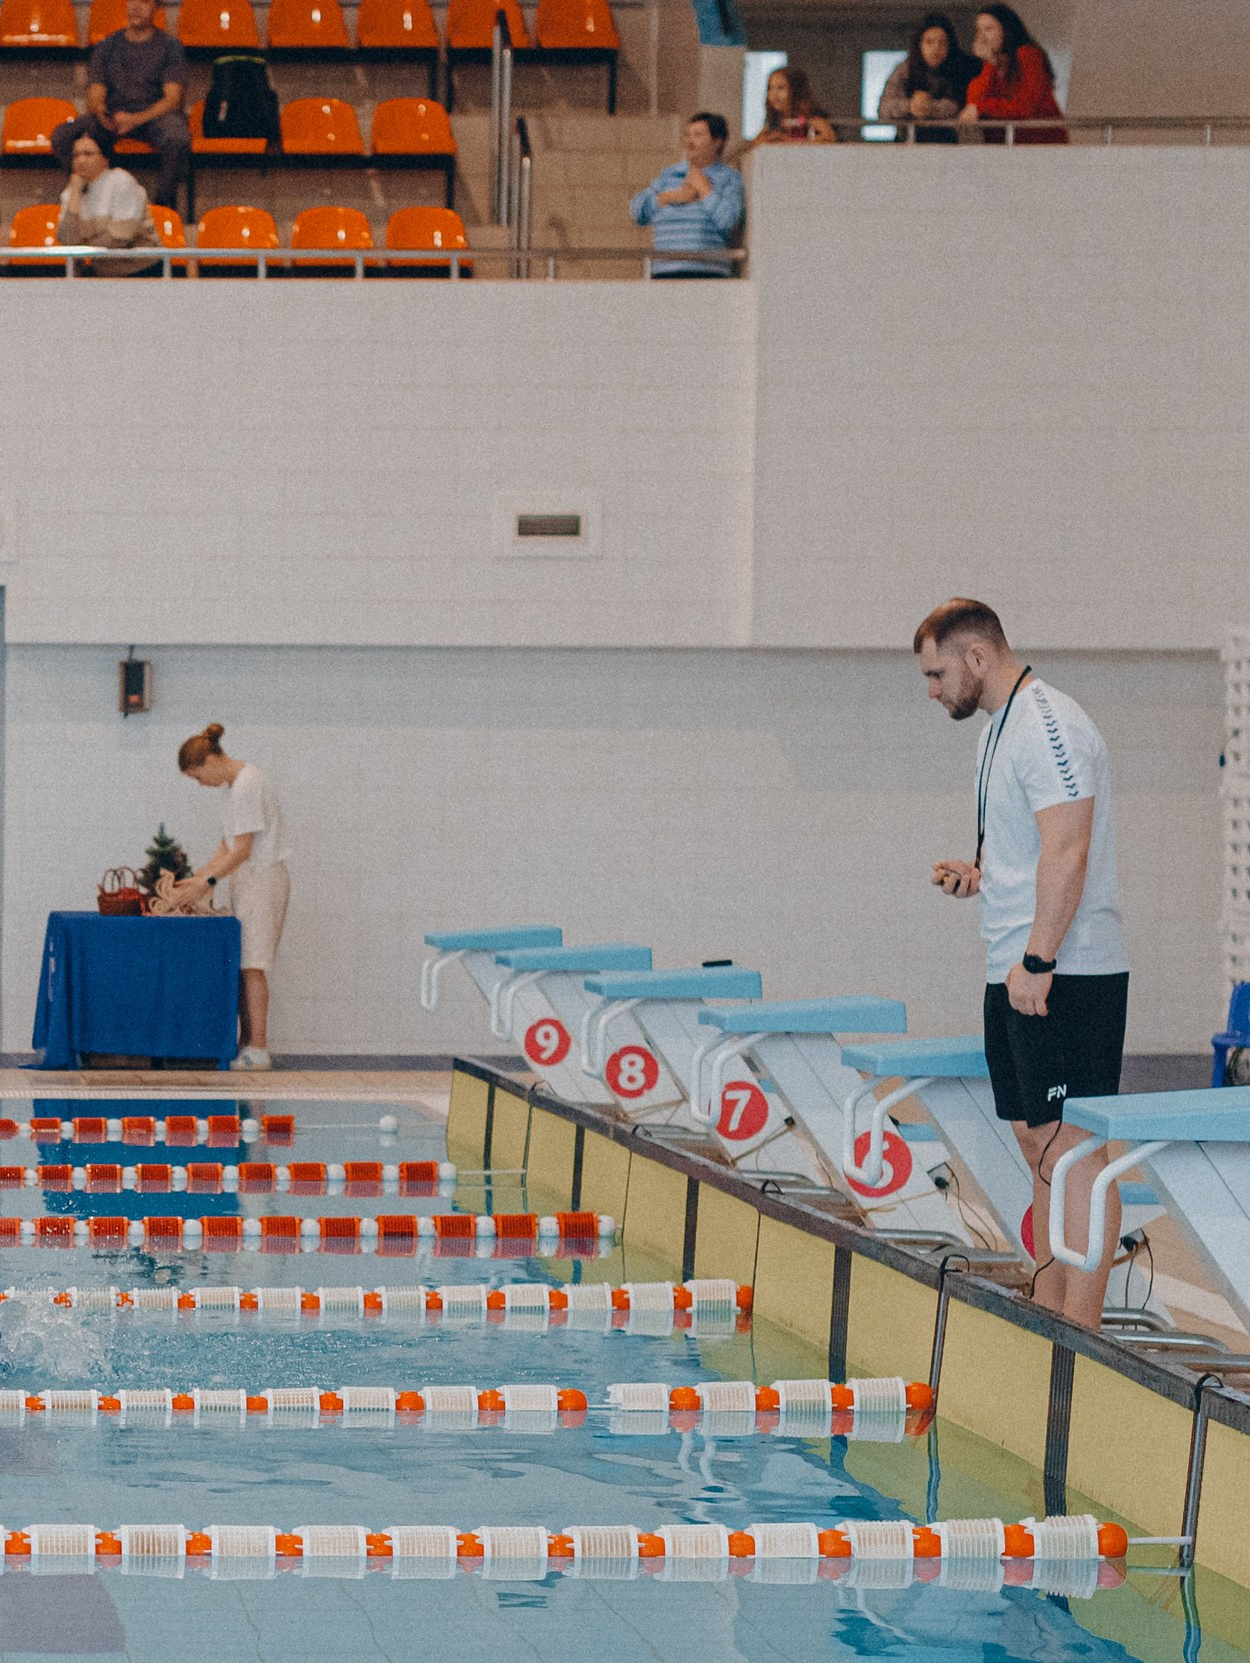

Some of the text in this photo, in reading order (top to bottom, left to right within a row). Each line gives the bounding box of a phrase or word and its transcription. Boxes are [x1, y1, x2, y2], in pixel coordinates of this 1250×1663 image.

[535, 1024, 559, 1059] 9
[618, 1053, 646, 1090] 8
[725, 1089, 752, 1132] 7
[1047, 1083, 1067, 1102] FN
